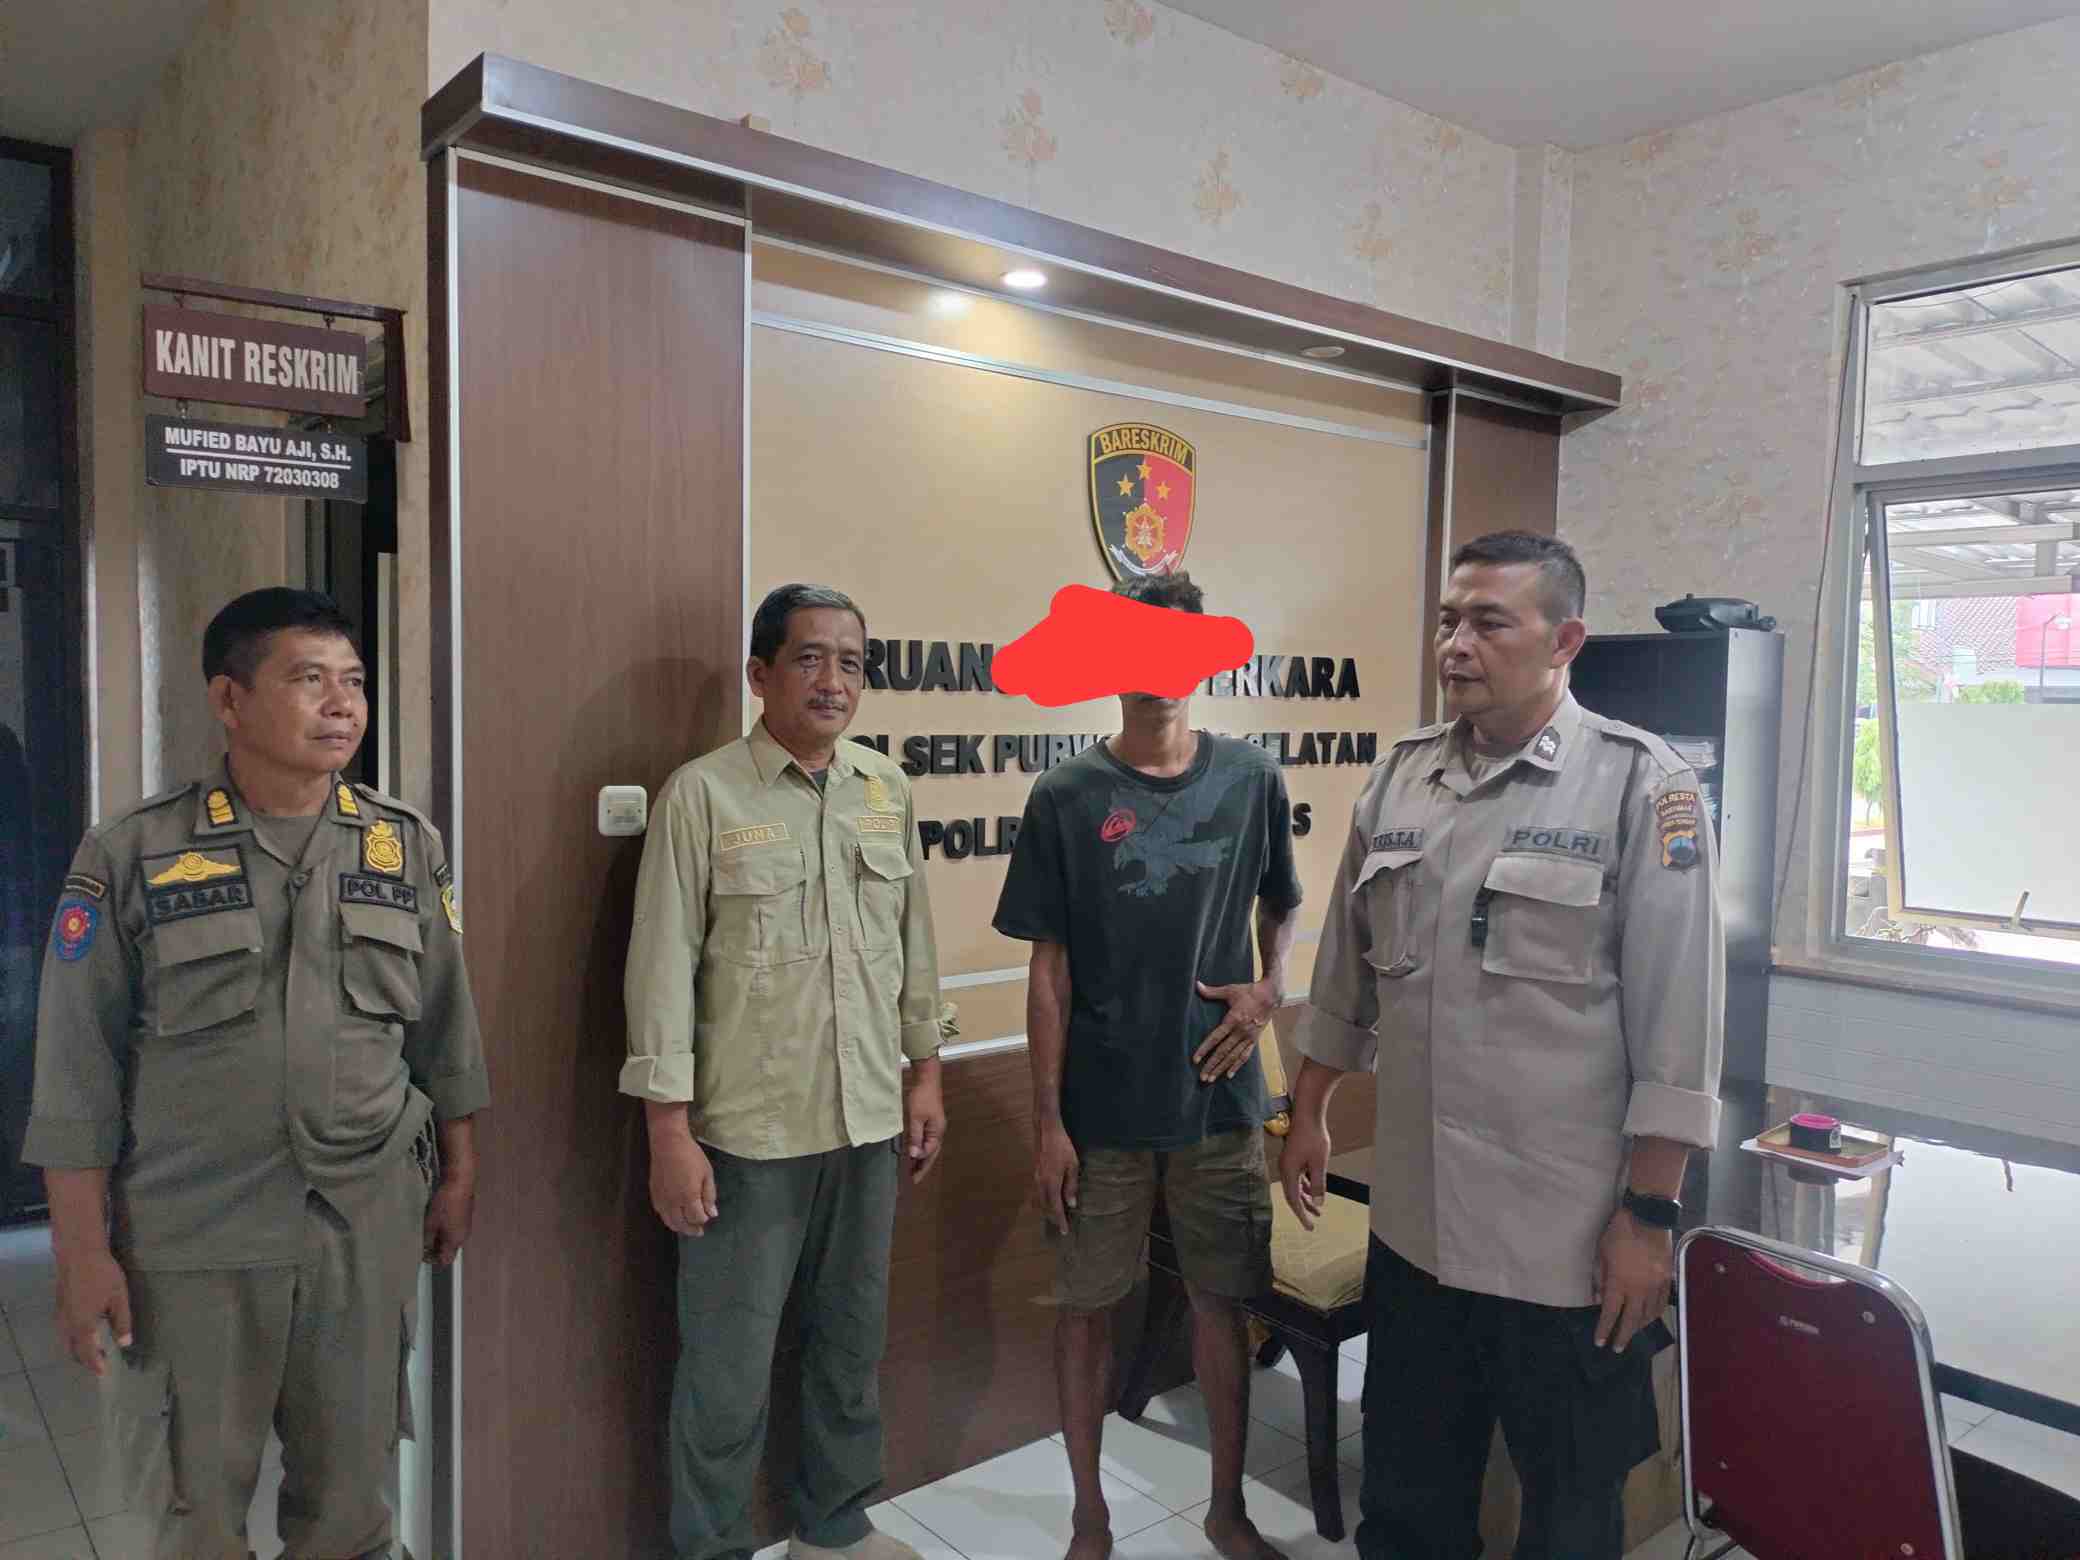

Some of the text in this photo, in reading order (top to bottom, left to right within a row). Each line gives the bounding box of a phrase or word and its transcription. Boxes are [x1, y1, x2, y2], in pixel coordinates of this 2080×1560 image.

[156, 329, 358, 395] KANIT RESKRIM
[165, 426, 352, 462] MUFIED BAYU AJI, S.H.
[1100, 428, 1188, 465] BARESKRIM
[180, 458, 340, 489] IPTU NRP 72030308
[863, 638, 1007, 694] RUAN
[917, 816, 1023, 861] POLR
[1512, 830, 1600, 855] POLRI
